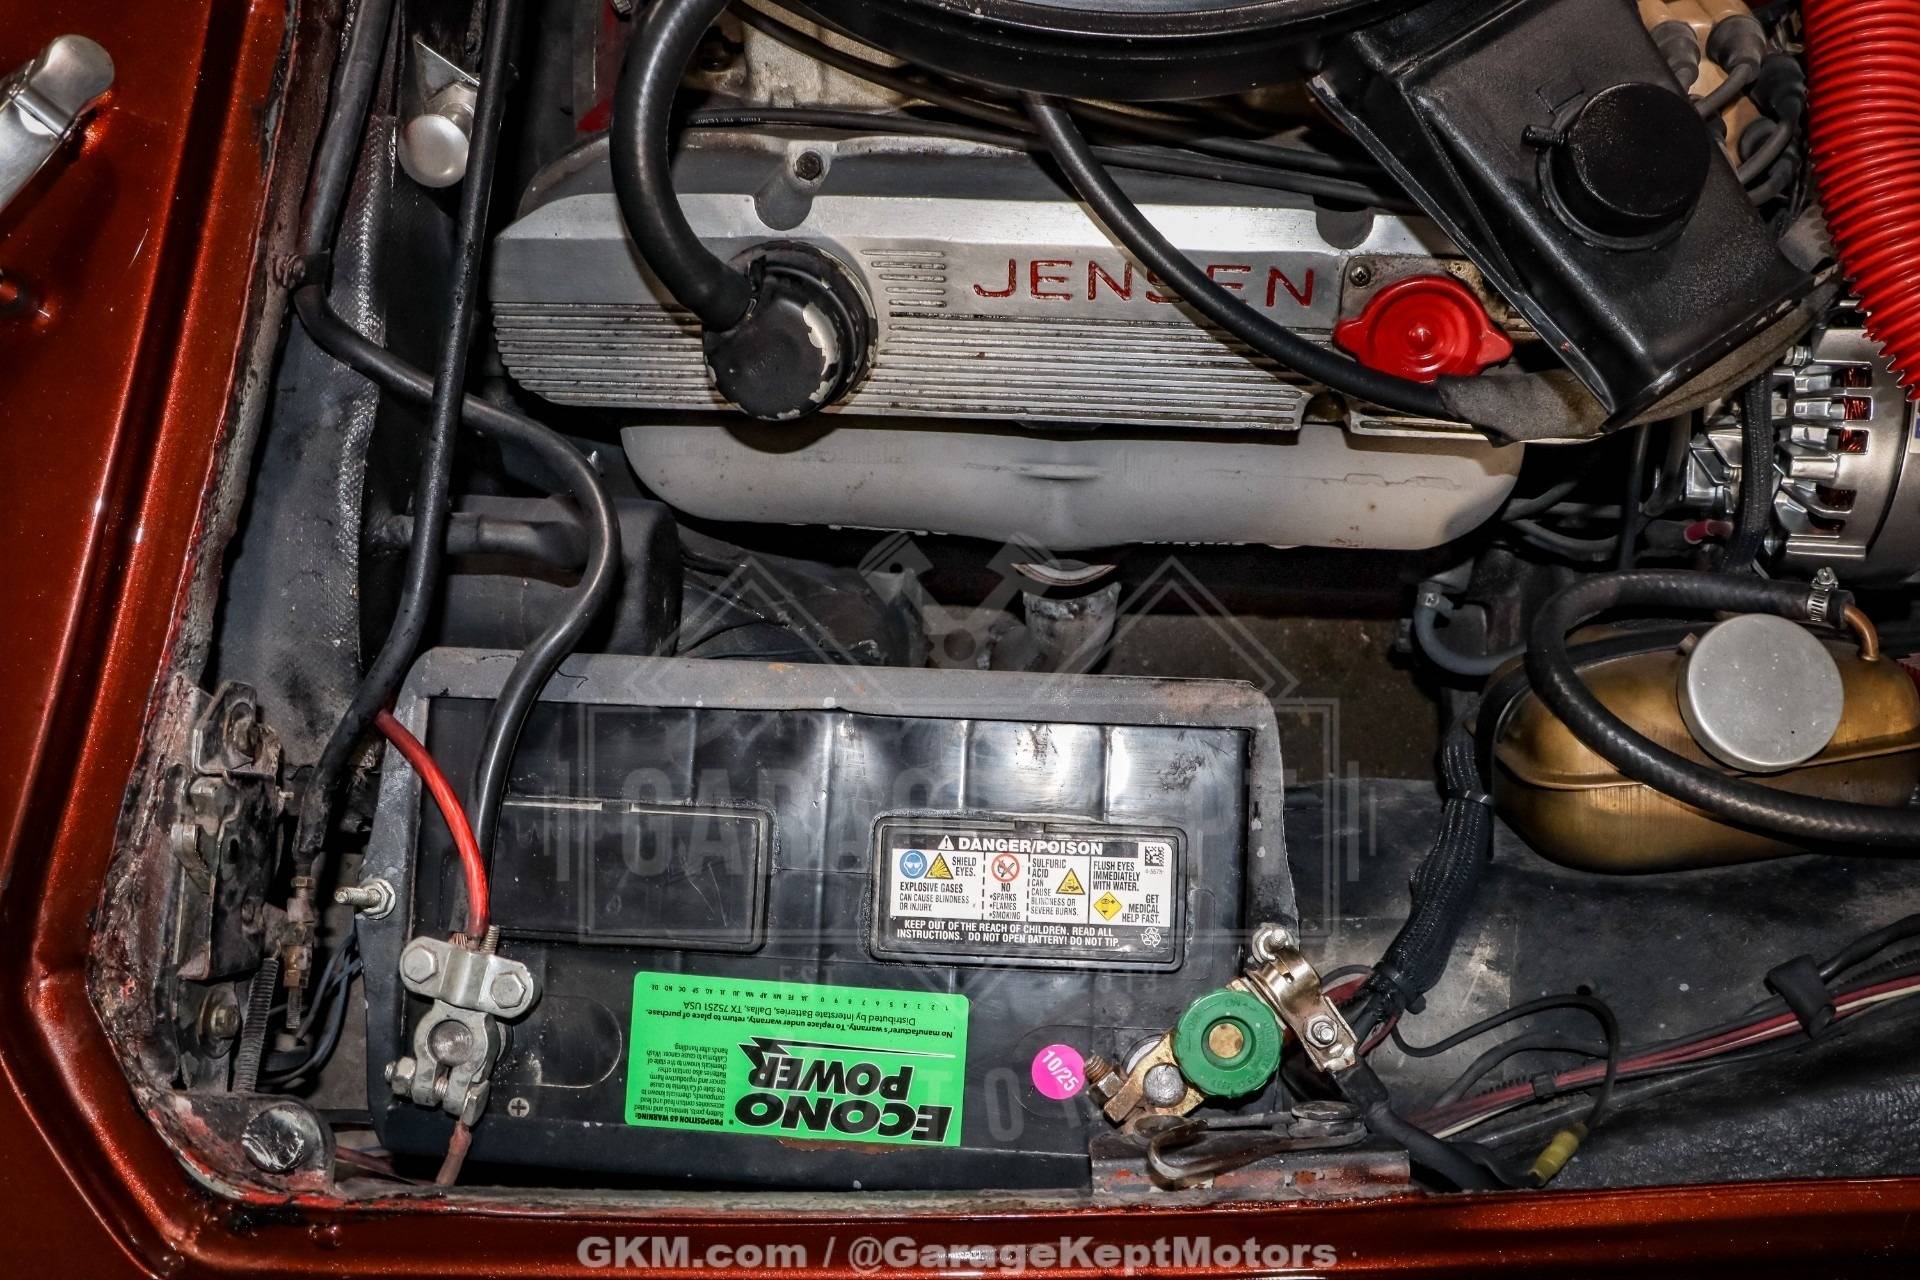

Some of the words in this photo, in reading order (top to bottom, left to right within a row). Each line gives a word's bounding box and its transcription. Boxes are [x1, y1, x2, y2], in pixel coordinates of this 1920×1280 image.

[958, 837, 1104, 856] DANGER/POISON
[952, 855, 977, 866] SHIELD
[1032, 858, 1067, 869] SULFURIC
[956, 867, 976, 877] EYES.
[1093, 861, 1115, 871] FLUSH
[1117, 861, 1135, 872] EYES
[1032, 868, 1049, 878] ACID
[1093, 871, 1141, 881] IMMEDIATELY
[900, 881, 938, 892] EXPLOSIVE
[940, 883, 963, 894] GASES
[1001, 882, 1011, 893] NO
[1031, 878, 1044, 887] CAN
[1093, 881, 1111, 890] WITH
[1113, 881, 1140, 892] WATER.
[899, 892, 912, 902] CAN
[913, 893, 933, 903] CAUSE
[935, 894, 970, 904] BLINDNESS
[1031, 888, 1052, 897] CAUSE
[1031, 896, 1066, 906] BLINDNESS
[1067, 898, 1076, 907] OR
[1145, 894, 1160, 904] GET
[899, 902, 908, 911] OR
[1031, 906, 1054, 915] SEVERE
[1055, 907, 1079, 916] BURNS.
[1128, 903, 1160, 914] MEDICAL
[1122, 913, 1140, 923] HELP
[1141, 914, 1161, 924] FAST.
[904, 919, 926, 930] KEEP
[928, 920, 945, 930] OUT
[947, 921, 959, 931] OF
[960, 921, 977, 932] THE
[979, 922, 1008, 933] REACH
[1009, 923, 1022, 934] OF
[1023, 925, 1069, 936] CHILDREN.
[1072, 926, 1096, 937] READ
[1097, 927, 1114, 937] ALL
[897, 929, 963, 941] INSTRUCTIONS.
[968, 932, 981, 941] DO
[983, 933, 1001, 942] NOT
[1002, 933, 1026, 943] OPEN
[1027, 934, 1068, 945] BATTERY!
[1069, 936, 1083, 946] DO
[1084, 937, 1102, 947] NOT
[1104, 938, 1121, 948] TIP.
[682, 1000, 702, 1010] USA
[703, 1002, 729, 1012] 75251
[730, 1004, 742, 1013] TX
[743, 1003, 772, 1015] Dallas,
[645, 1006, 682, 1018] purchase.
[681, 1011, 690, 1019] of
[692, 1010, 712, 1020] place
[713, 1013, 721, 1021] to
[773, 1005, 813, 1018] Batteries,
[814, 1010, 854, 1021] Interstate
[856, 1011, 866, 1022] by
[722, 1014, 745, 1023] return
[746, 1014, 781, 1025] warranty,
[783, 1018, 805, 1027] under
[806, 1018, 834, 1029] replace
[868, 1014, 915, 1026] Distributed
[835, 1022, 845, 1030] To
[846, 1021, 882, 1033] warranty.
[883, 1026, 939, 1037] manufacturer's
[941, 1030, 952, 1038] No
[738, 1043, 915, 1101] POWER
[1042, 1050, 1079, 1091] 10/25
[665, 1090, 691, 1098] chemicals
[639, 1096, 651, 1104] lead
[675, 1099, 695, 1107] contain
[652, 1105, 663, 1113] and
[705, 1108, 724, 1117] Battery
[634, 1112, 669, 1121] WARNING:
[679, 1115, 723, 1125] PROPOSITION
[734, 1092, 953, 1143] ECONO
